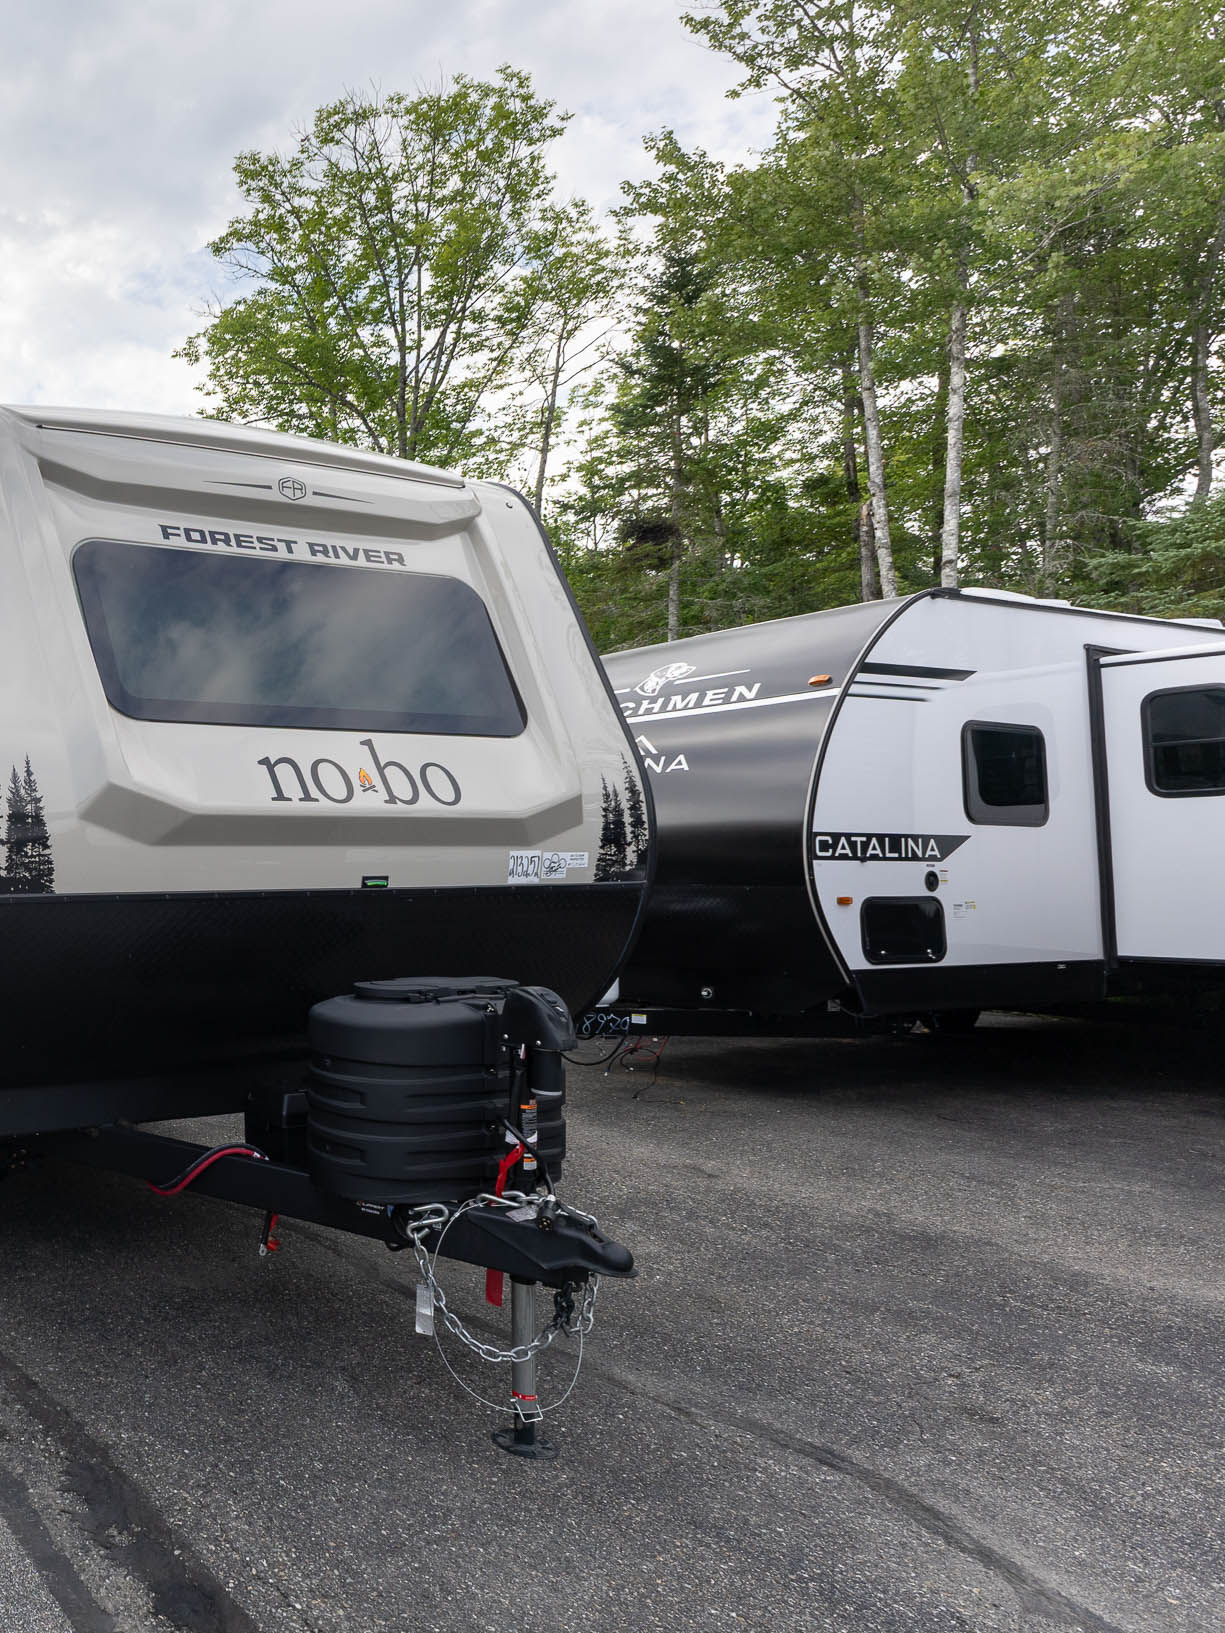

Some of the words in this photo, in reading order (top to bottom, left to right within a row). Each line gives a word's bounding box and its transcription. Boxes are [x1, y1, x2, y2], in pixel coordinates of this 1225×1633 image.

[158, 523, 298, 554] FOREST
[306, 541, 407, 567] RIVER
[619, 683, 762, 717] CHMEN
[815, 835, 941, 858] CATALINA
